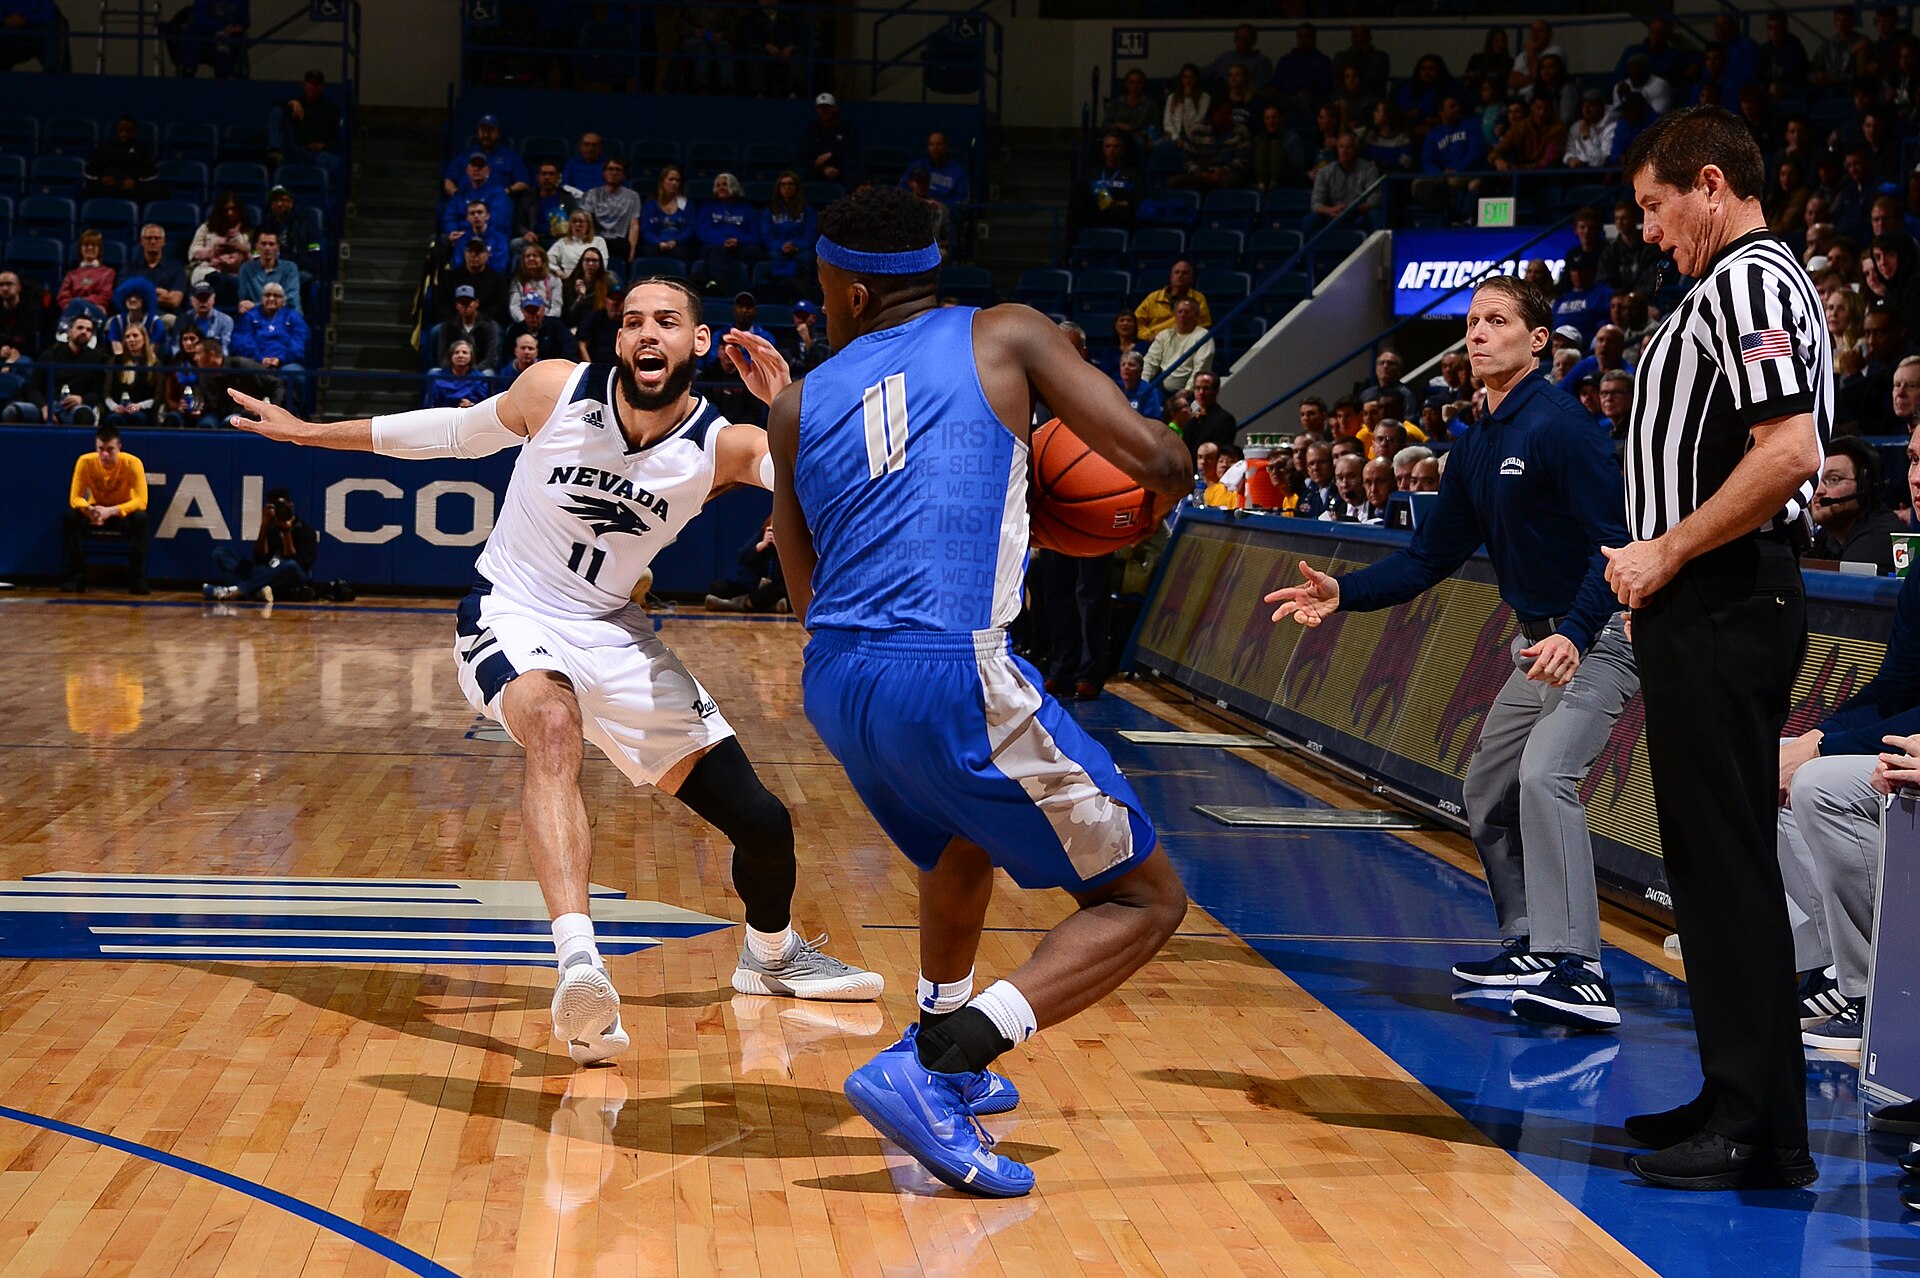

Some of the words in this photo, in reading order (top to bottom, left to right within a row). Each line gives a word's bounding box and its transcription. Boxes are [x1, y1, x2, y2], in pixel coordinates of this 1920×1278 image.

[1484, 202, 1509, 224] EXIT
[862, 372, 909, 480] 11
[922, 419, 1002, 451] FIRST
[949, 454, 1004, 477] SELF
[547, 466, 669, 522] NEVADA
[947, 480, 974, 499] WE
[982, 481, 1003, 501] DO
[147, 472, 495, 547] ALCO
[917, 504, 1001, 536] FIRST
[567, 541, 607, 586] 11
[945, 540, 998, 565] SELF
[941, 566, 968, 586] WE
[975, 568, 993, 589] DO
